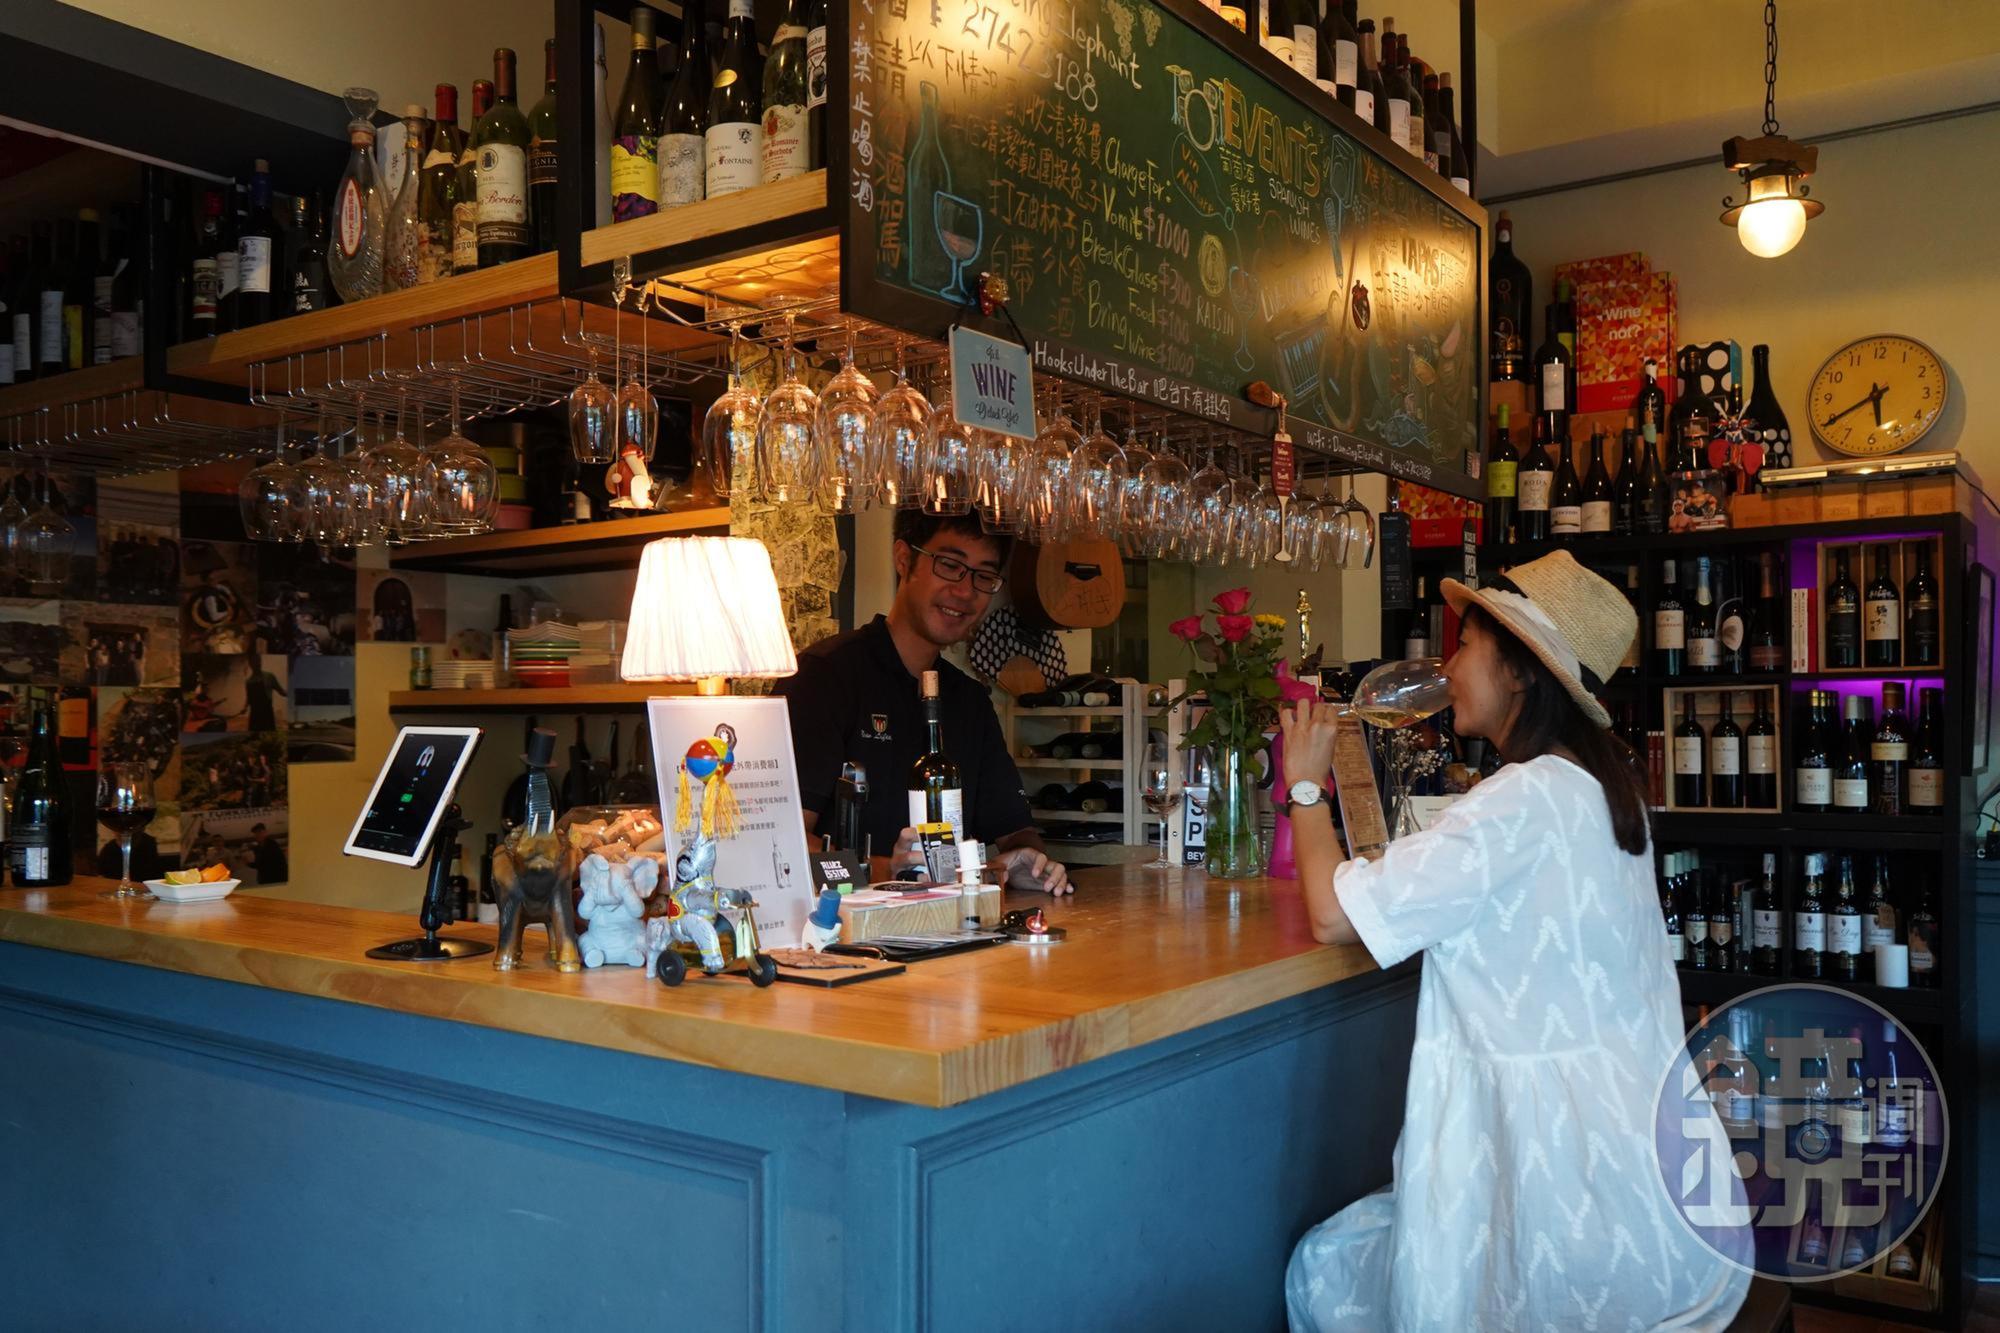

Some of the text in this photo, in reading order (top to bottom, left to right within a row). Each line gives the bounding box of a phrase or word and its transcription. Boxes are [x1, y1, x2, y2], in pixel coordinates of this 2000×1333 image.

[1605, 306, 1642, 321] Wine
[1608, 324, 1642, 341] not?
[1874, 346, 1887, 360] 12
[1849, 354, 1861, 367] 11
[1829, 371, 1843, 384] 10
[1918, 366, 1926, 378] 2
[971, 363, 1017, 405] WINE
[1128, 368, 1149, 395] Bar
[1823, 392, 1833, 405] 9
[1922, 387, 1931, 399] 3
[1914, 409, 1922, 420] 4
[1844, 427, 1852, 441] 7
[1867, 433, 1877, 445] 6
